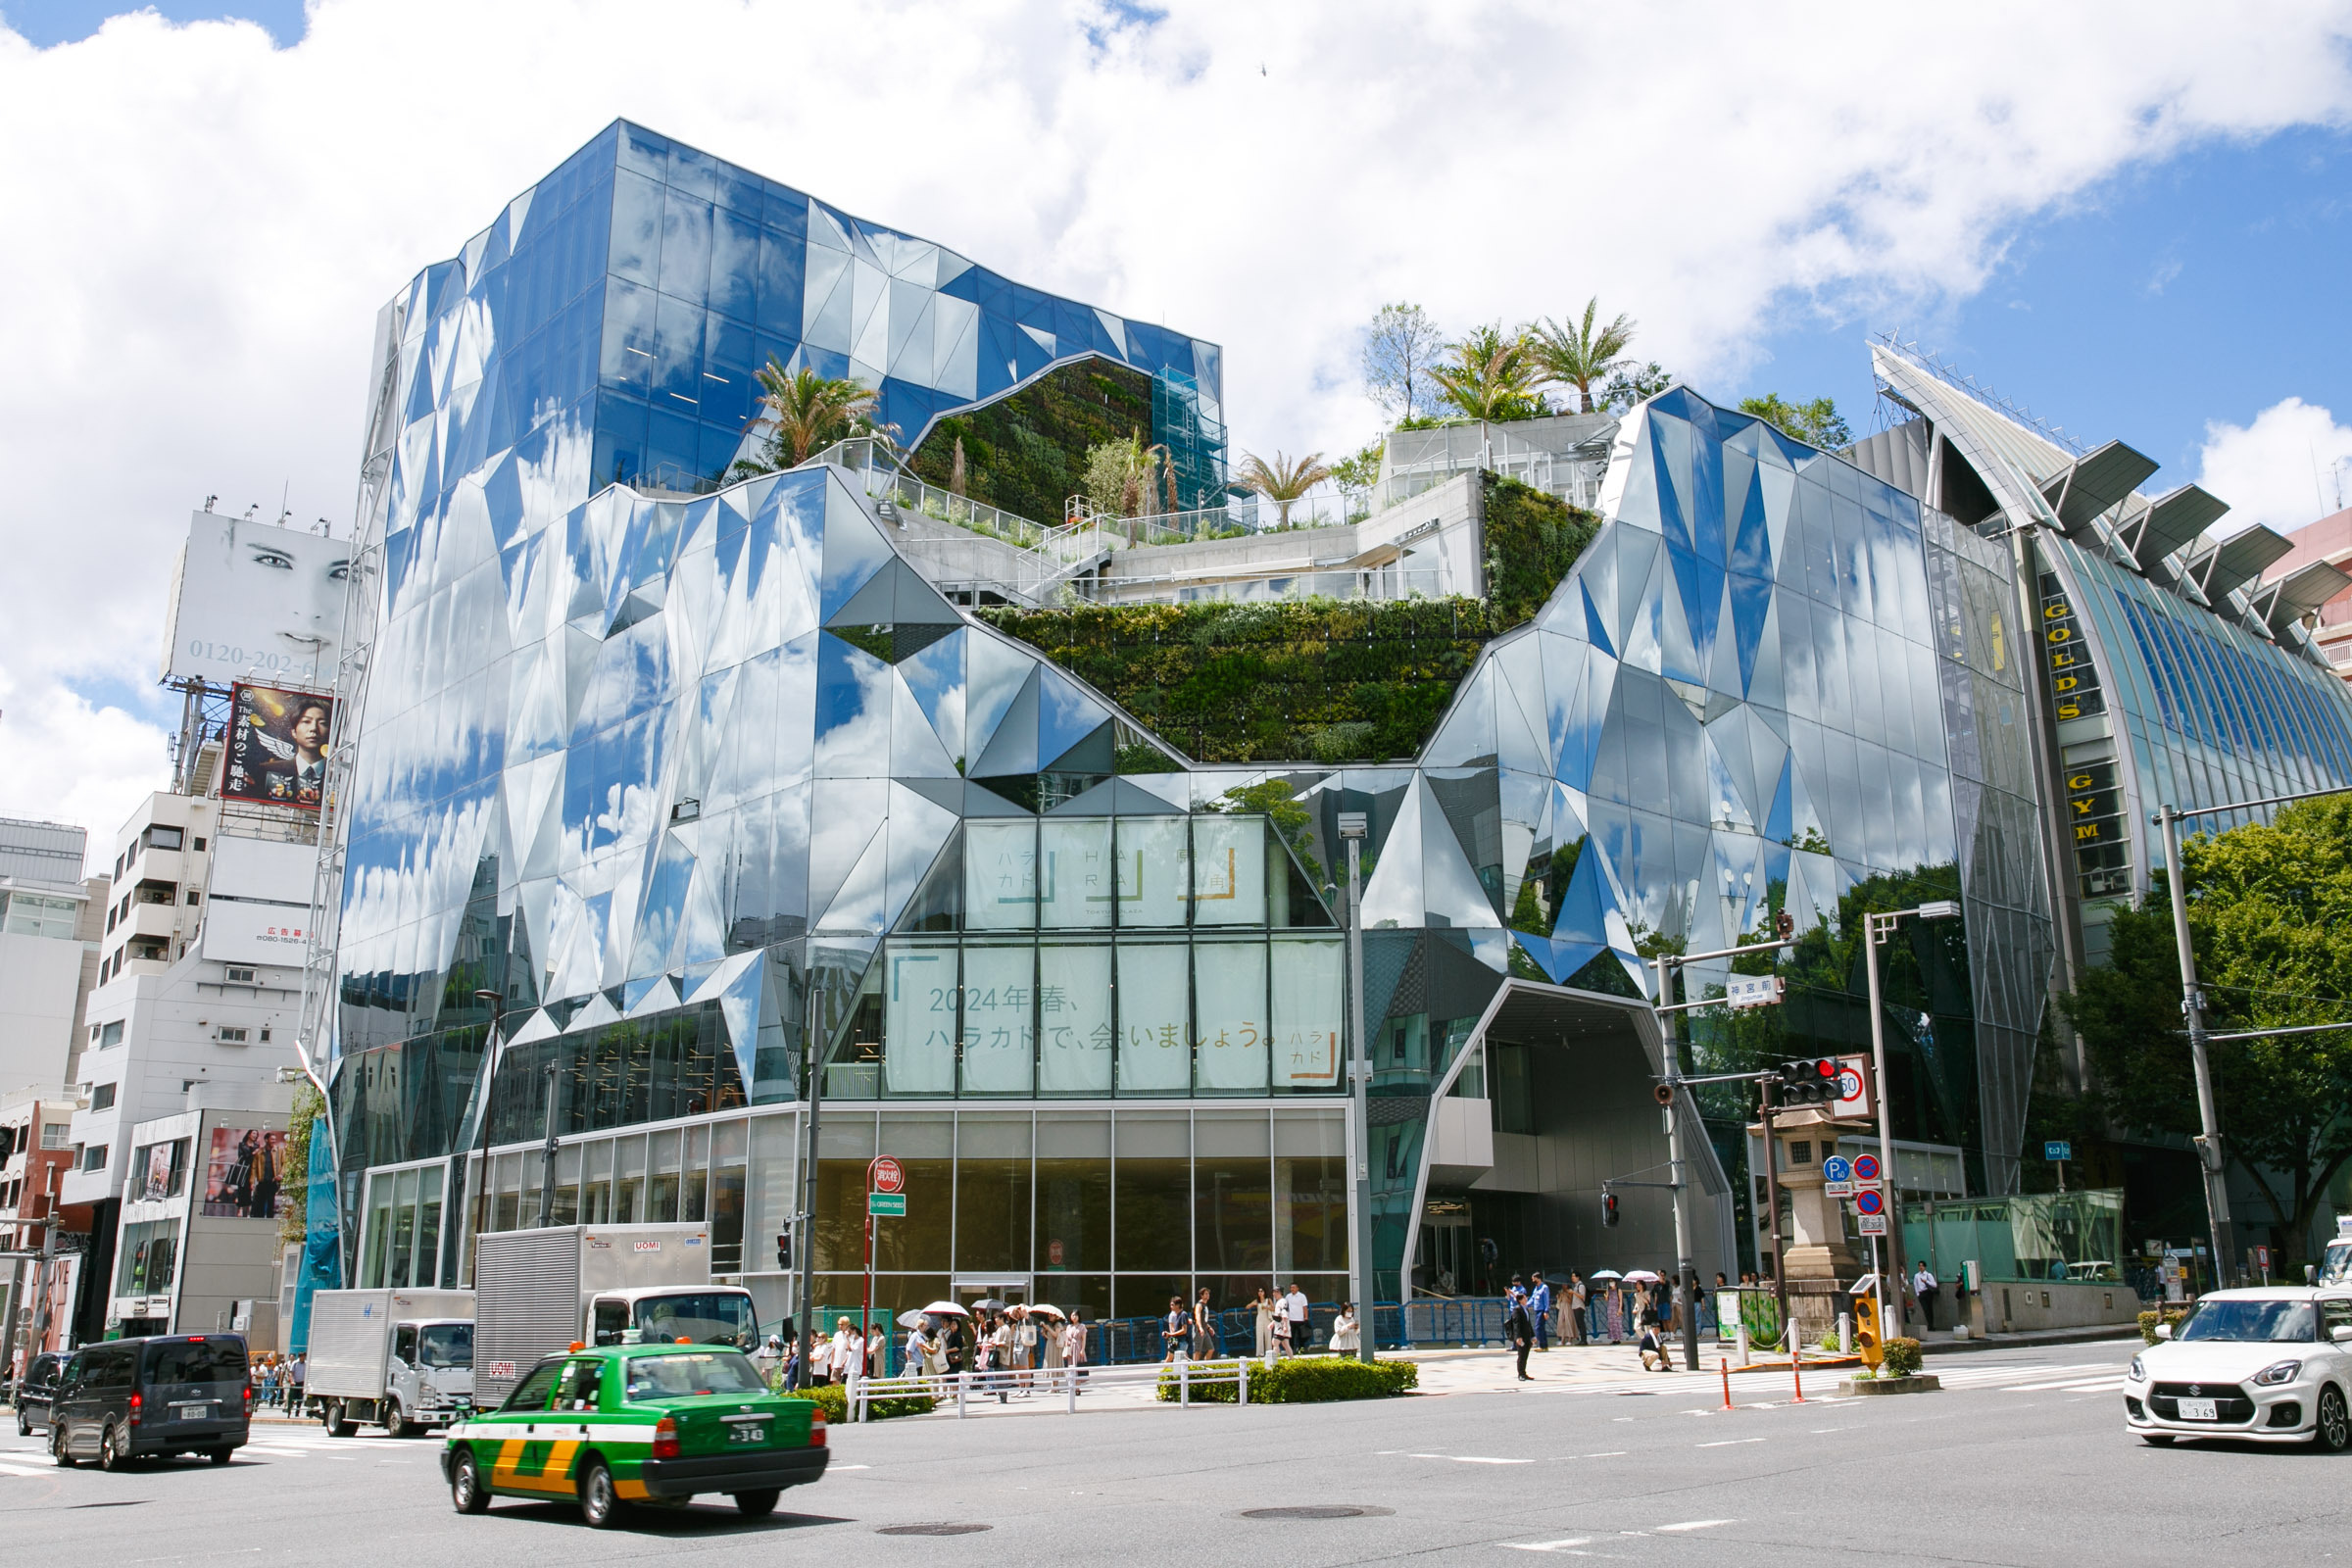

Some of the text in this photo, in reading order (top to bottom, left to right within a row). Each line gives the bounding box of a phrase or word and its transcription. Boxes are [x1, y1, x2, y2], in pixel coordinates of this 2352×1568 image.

[189, 639, 333, 678] 0120-202-6
[238, 706, 253, 715] The
[2045, 604, 2100, 840] GOLD'S GYM
[228, 714, 251, 792] 素材のご馳走
[998, 851, 1034, 865] ハラ
[999, 873, 1034, 888] カド
[1732, 980, 1771, 996] 神宮前
[930, 985, 1078, 1013] 2024年春、
[1290, 1031, 1323, 1044] ハラ
[1291, 1051, 1321, 1063] カド
[877, 1169, 899, 1183] 消火栓
[1830, 1162, 1840, 1179] P
[32, 1259, 72, 1286] LWE
[491, 1362, 514, 1376] UOMI
